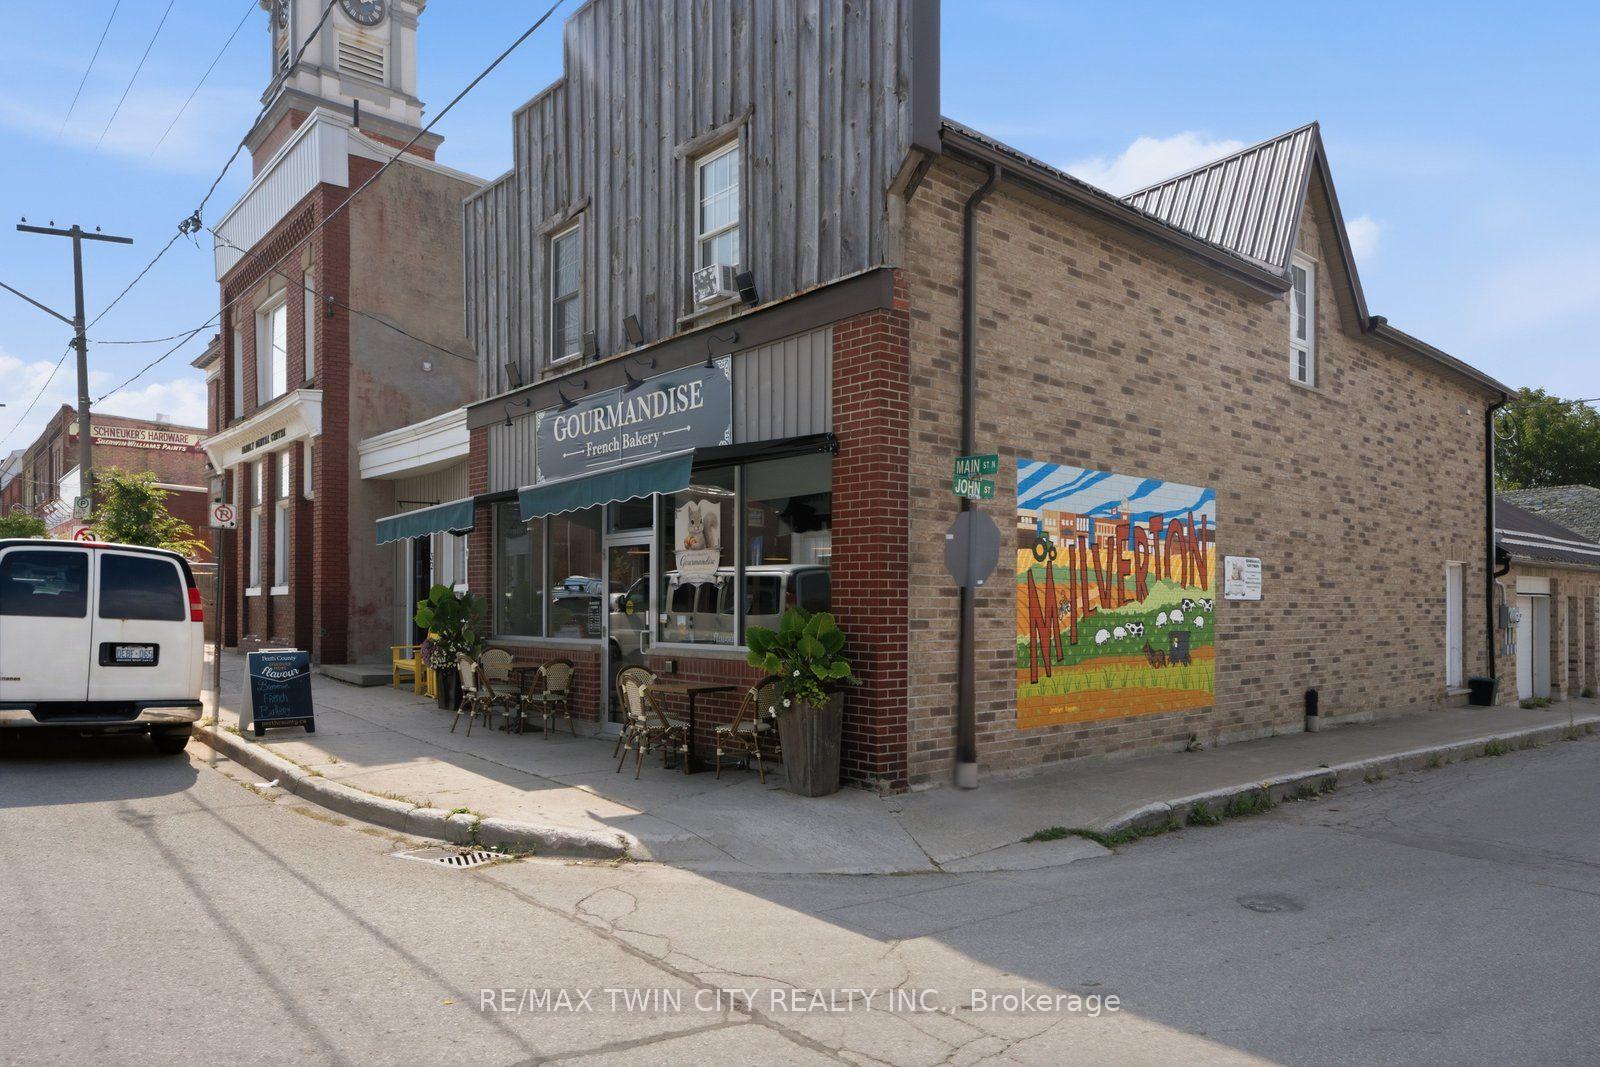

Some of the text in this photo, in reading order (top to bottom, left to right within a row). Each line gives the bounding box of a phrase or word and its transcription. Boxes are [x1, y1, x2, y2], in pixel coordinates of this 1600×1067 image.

[553, 380, 704, 442] GOURMANDISE
[93, 426, 189, 444] SCHNEUKER'S HARDWARE
[586, 430, 661, 457] French Bakery
[956, 458, 996, 475] MAIN ST N
[955, 479, 991, 496] JOHN ST
[1027, 511, 1209, 684] MILVERTON
